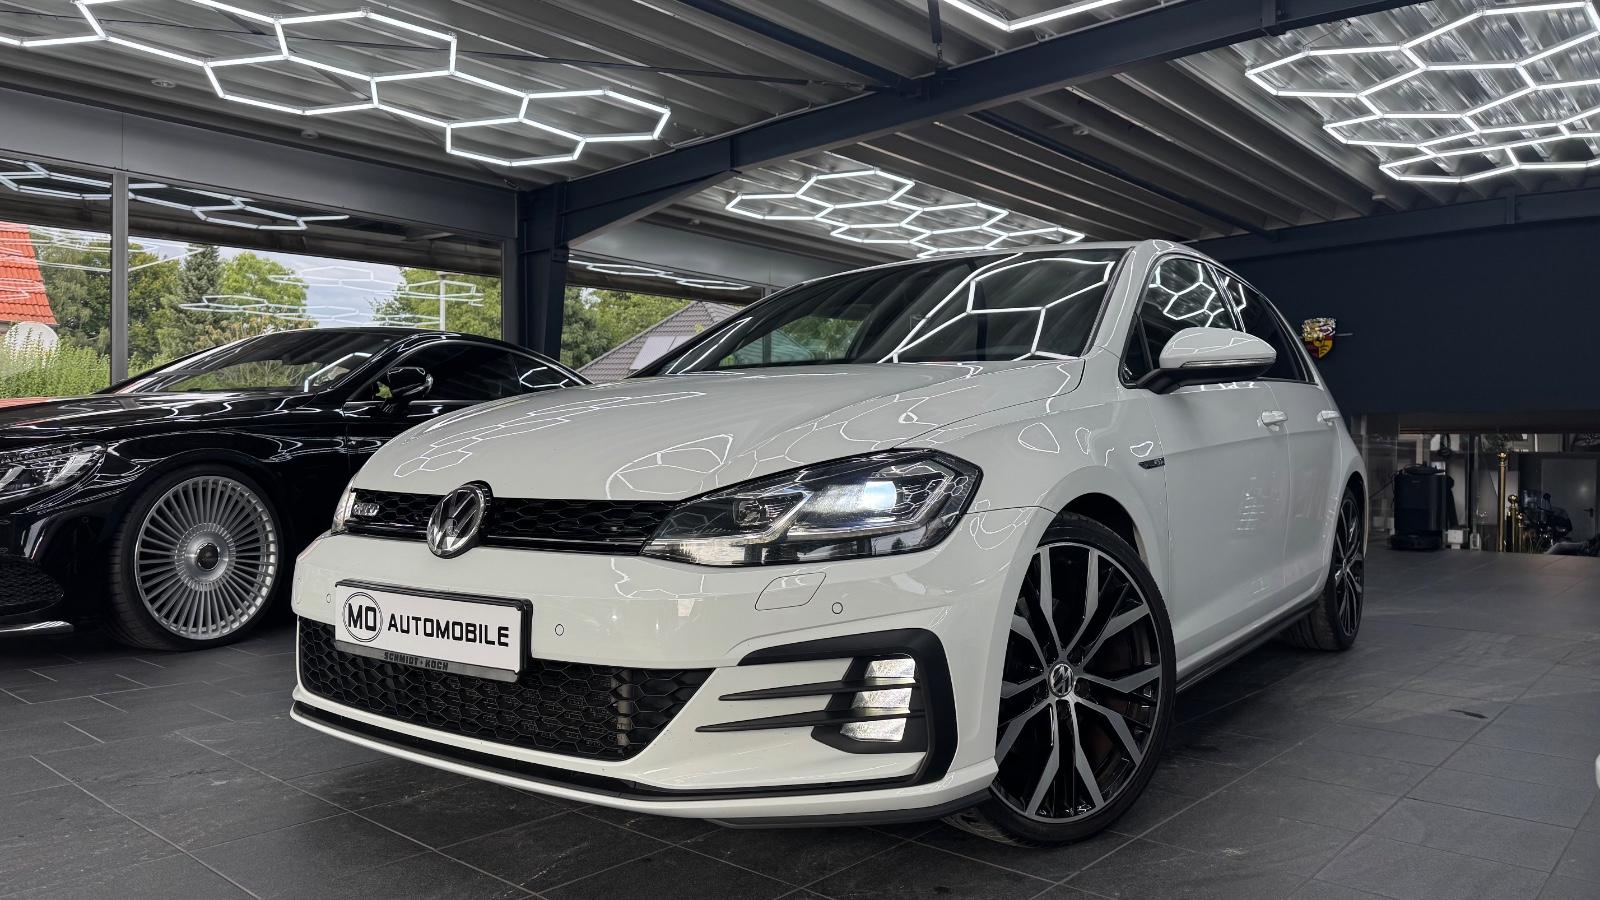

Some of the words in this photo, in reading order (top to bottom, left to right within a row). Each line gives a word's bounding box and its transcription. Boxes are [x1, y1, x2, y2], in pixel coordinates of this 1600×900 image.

[348, 602, 377, 632] MO
[388, 613, 509, 647] AUTOMOBILE
[384, 651, 419, 666] SCHMIDT
[425, 658, 449, 671] KOCH
